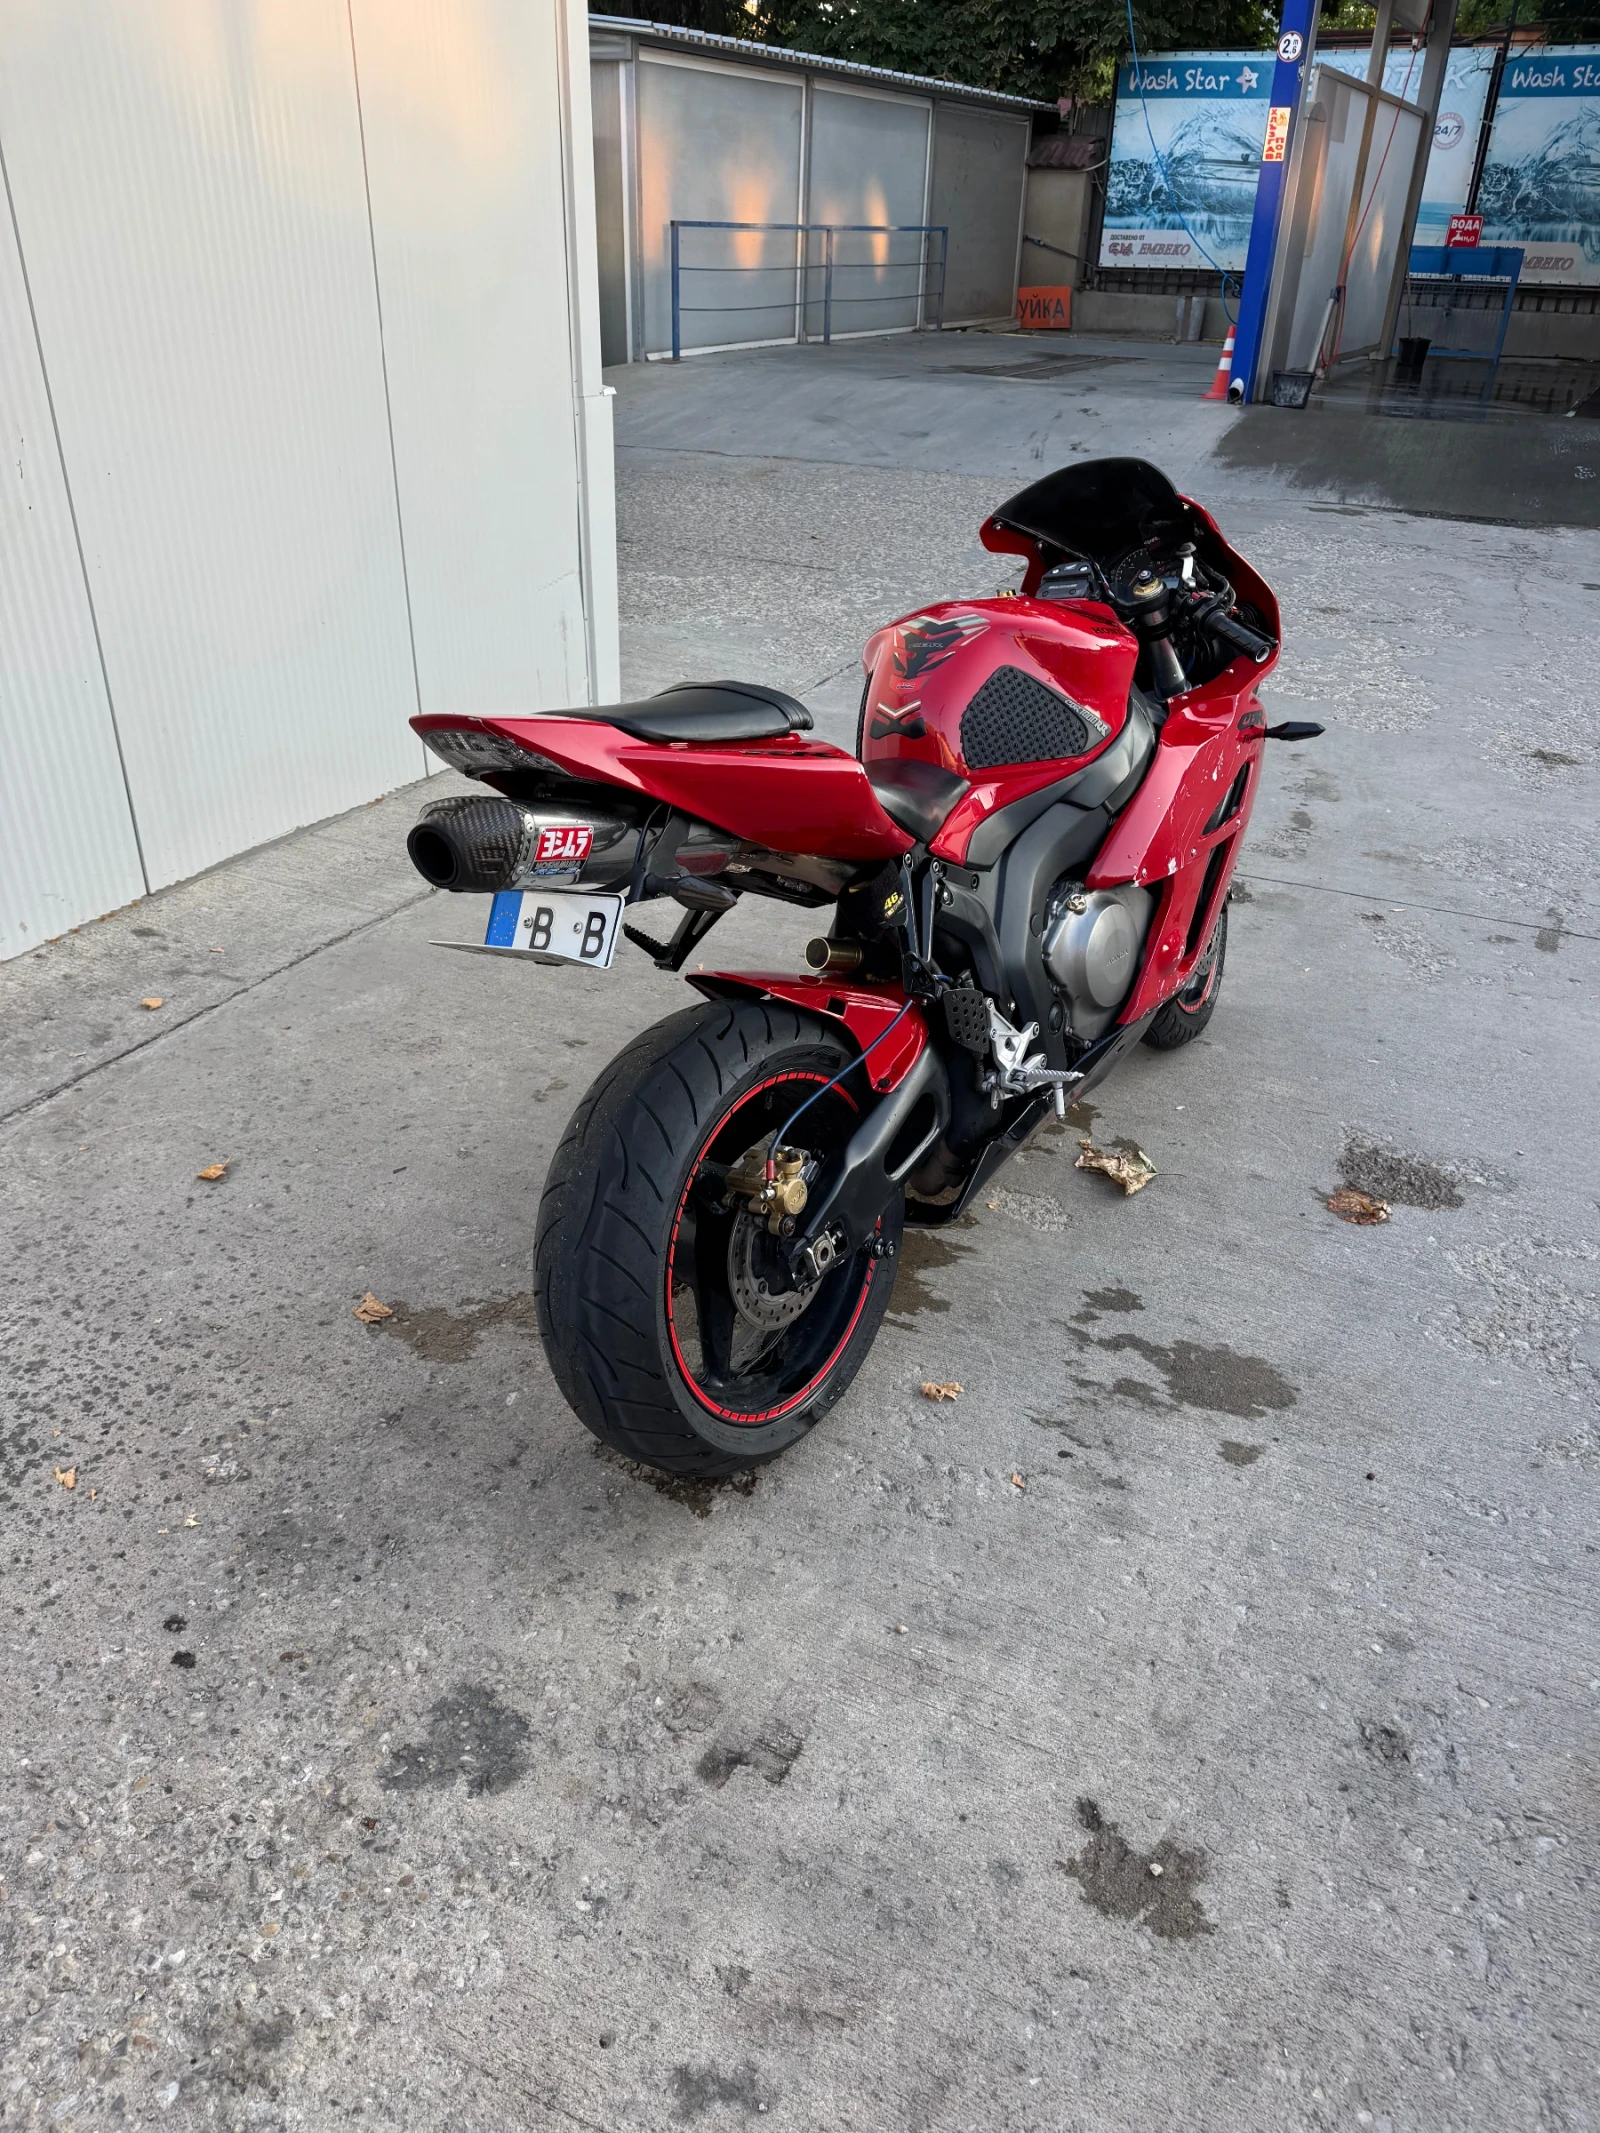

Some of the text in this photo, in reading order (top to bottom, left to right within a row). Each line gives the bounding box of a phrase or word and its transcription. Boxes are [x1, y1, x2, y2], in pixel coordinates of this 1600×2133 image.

[1129, 68, 1230, 91] Wash Star
[1511, 65, 1566, 89] Wash
[1434, 125, 1462, 137] 24/7
[1451, 219, 1480, 230] ВОДА
[541, 830, 589, 858] ヨシムラ
[884, 891, 899, 910] 46
[529, 906, 607, 958] B B
